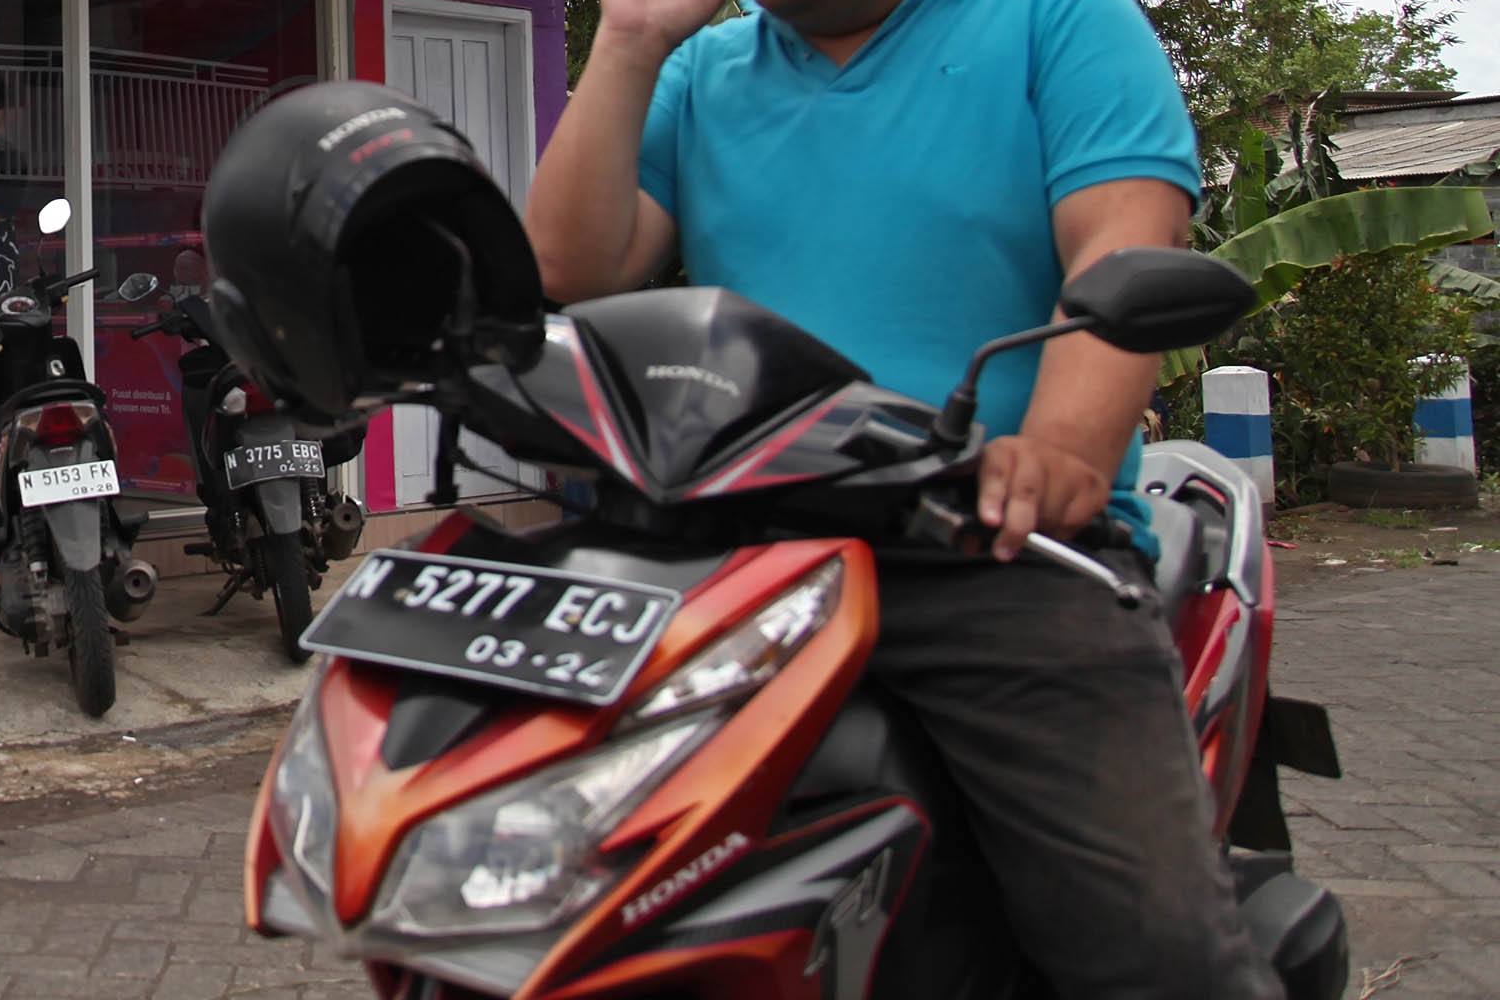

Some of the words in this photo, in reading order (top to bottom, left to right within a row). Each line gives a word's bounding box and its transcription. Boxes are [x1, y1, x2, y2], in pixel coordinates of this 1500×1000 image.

[646, 365, 740, 398] HONDA
[228, 454, 237, 469] N
[246, 445, 282, 463] 3775
[292, 444, 318, 458] EBC
[23, 474, 33, 489] N
[42, 467, 81, 486] 5153
[89, 462, 111, 479] FK
[345, 557, 396, 599] N
[404, 565, 536, 621] 5277
[544, 585, 661, 645] ECJ
[621, 831, 750, 925] HONDA
